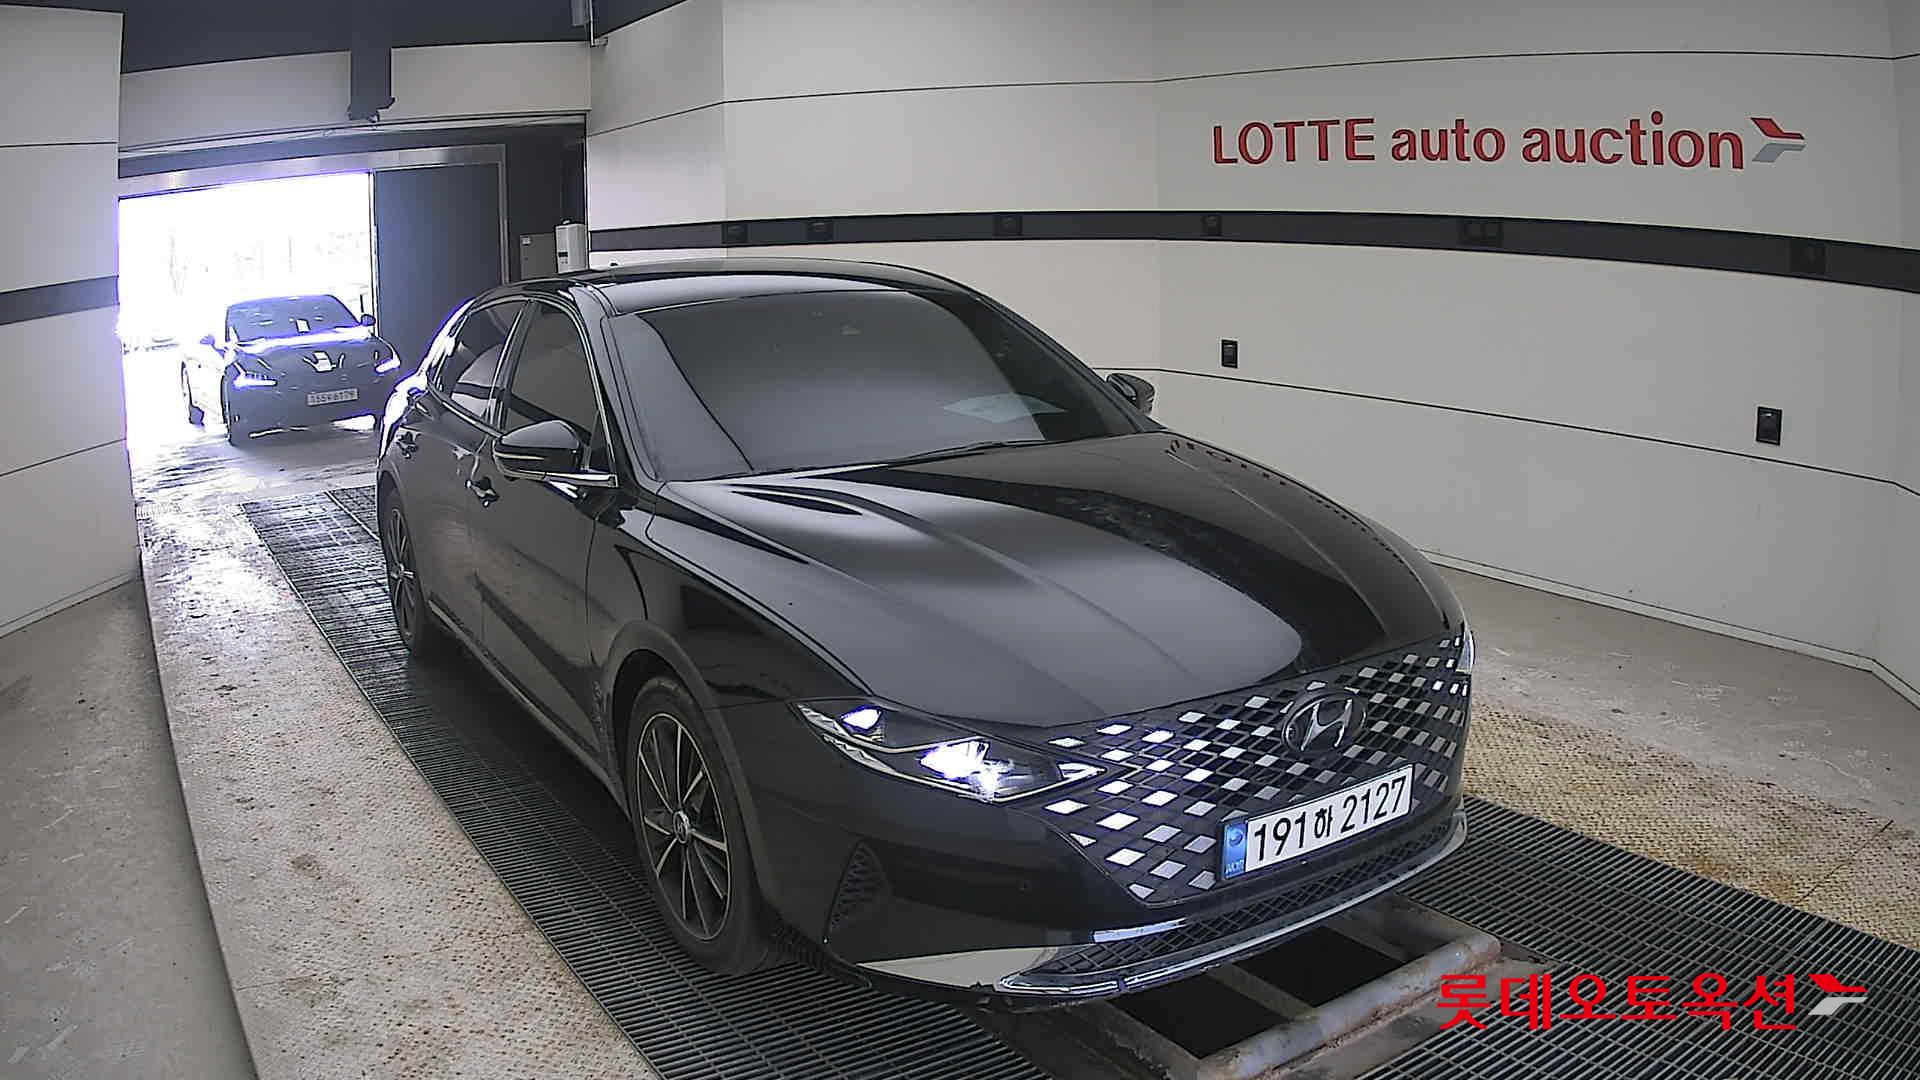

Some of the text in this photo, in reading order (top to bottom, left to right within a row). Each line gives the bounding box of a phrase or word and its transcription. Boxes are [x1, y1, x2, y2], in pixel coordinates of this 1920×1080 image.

[1212, 110, 1745, 169] LOTTE auto auction
[1254, 776, 1407, 861] 191하 2127
